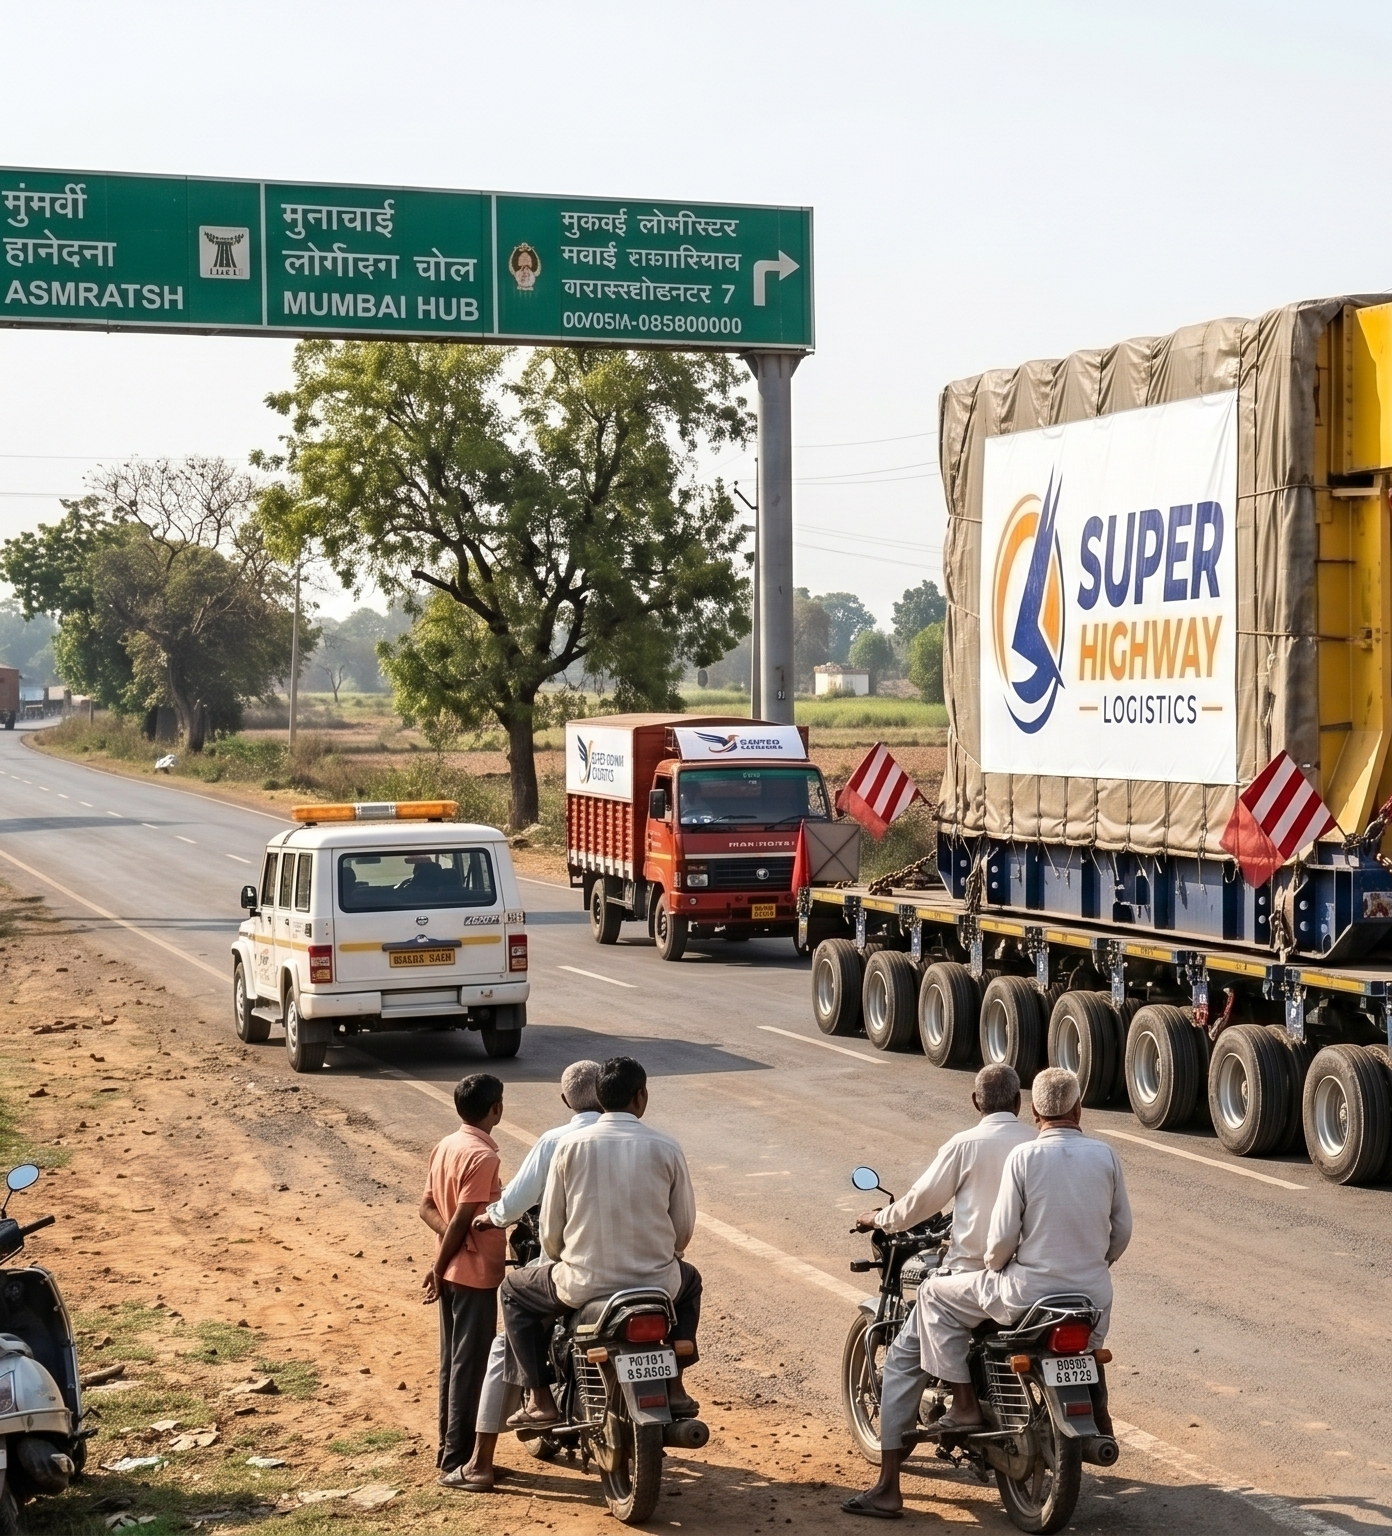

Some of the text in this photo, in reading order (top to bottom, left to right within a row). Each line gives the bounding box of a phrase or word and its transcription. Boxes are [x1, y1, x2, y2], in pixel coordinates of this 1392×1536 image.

[413, 247, 477, 282] चोल
[4, 280, 184, 310] ASMRATSH
[283, 291, 479, 321] MUMBAI HUB
[1076, 500, 1225, 611] SUPER
[1078, 615, 1224, 681] HIGHWAY
[1102, 694, 1198, 725] LOGISTICS
